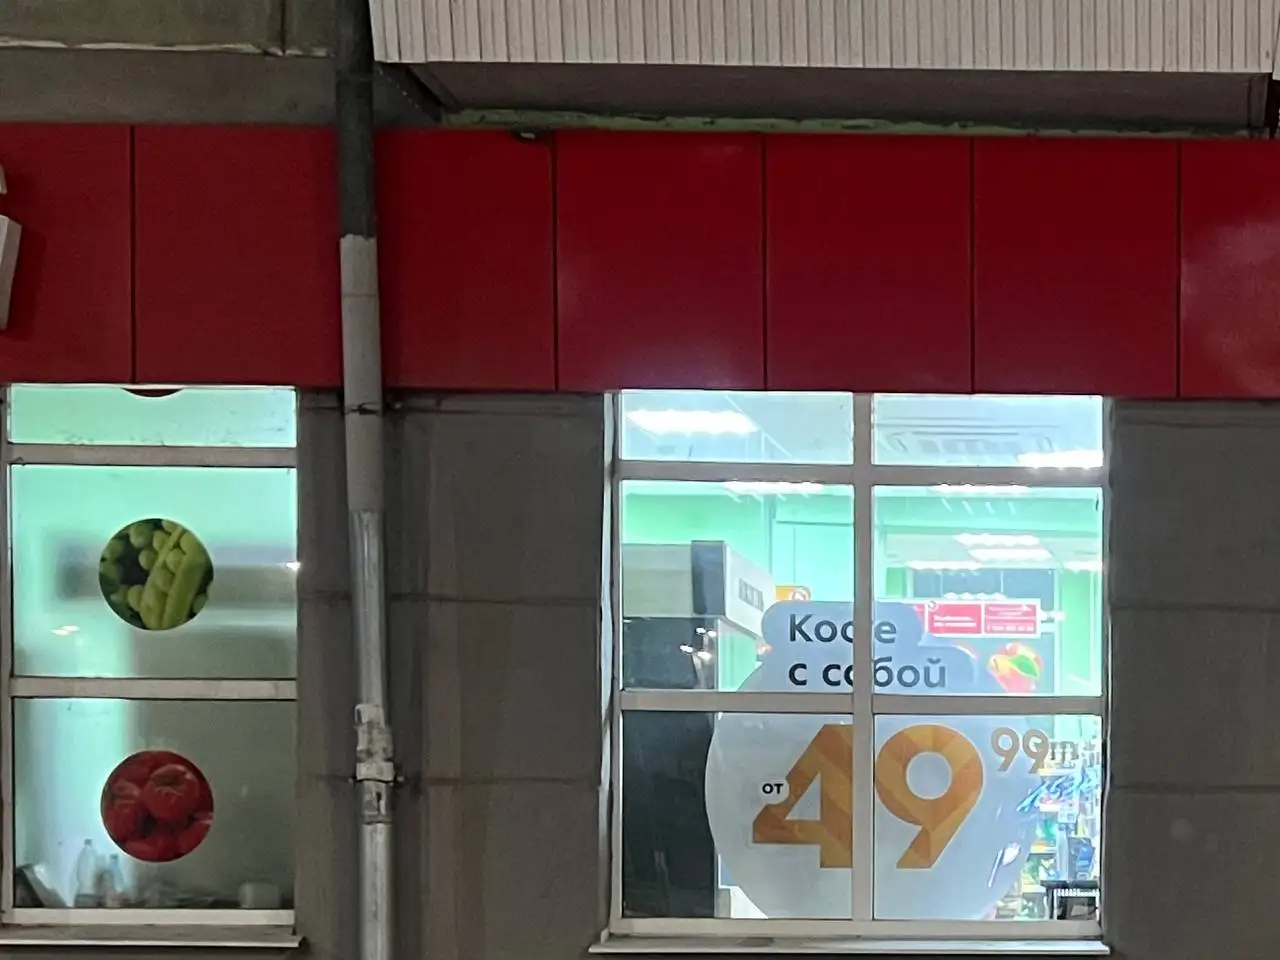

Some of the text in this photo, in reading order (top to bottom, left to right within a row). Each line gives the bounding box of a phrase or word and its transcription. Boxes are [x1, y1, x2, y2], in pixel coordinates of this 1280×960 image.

[788, 662, 808, 687] с
[990, 727, 1050, 774] 99
[752, 723, 984, 869] 49
[761, 782, 784, 795] от
